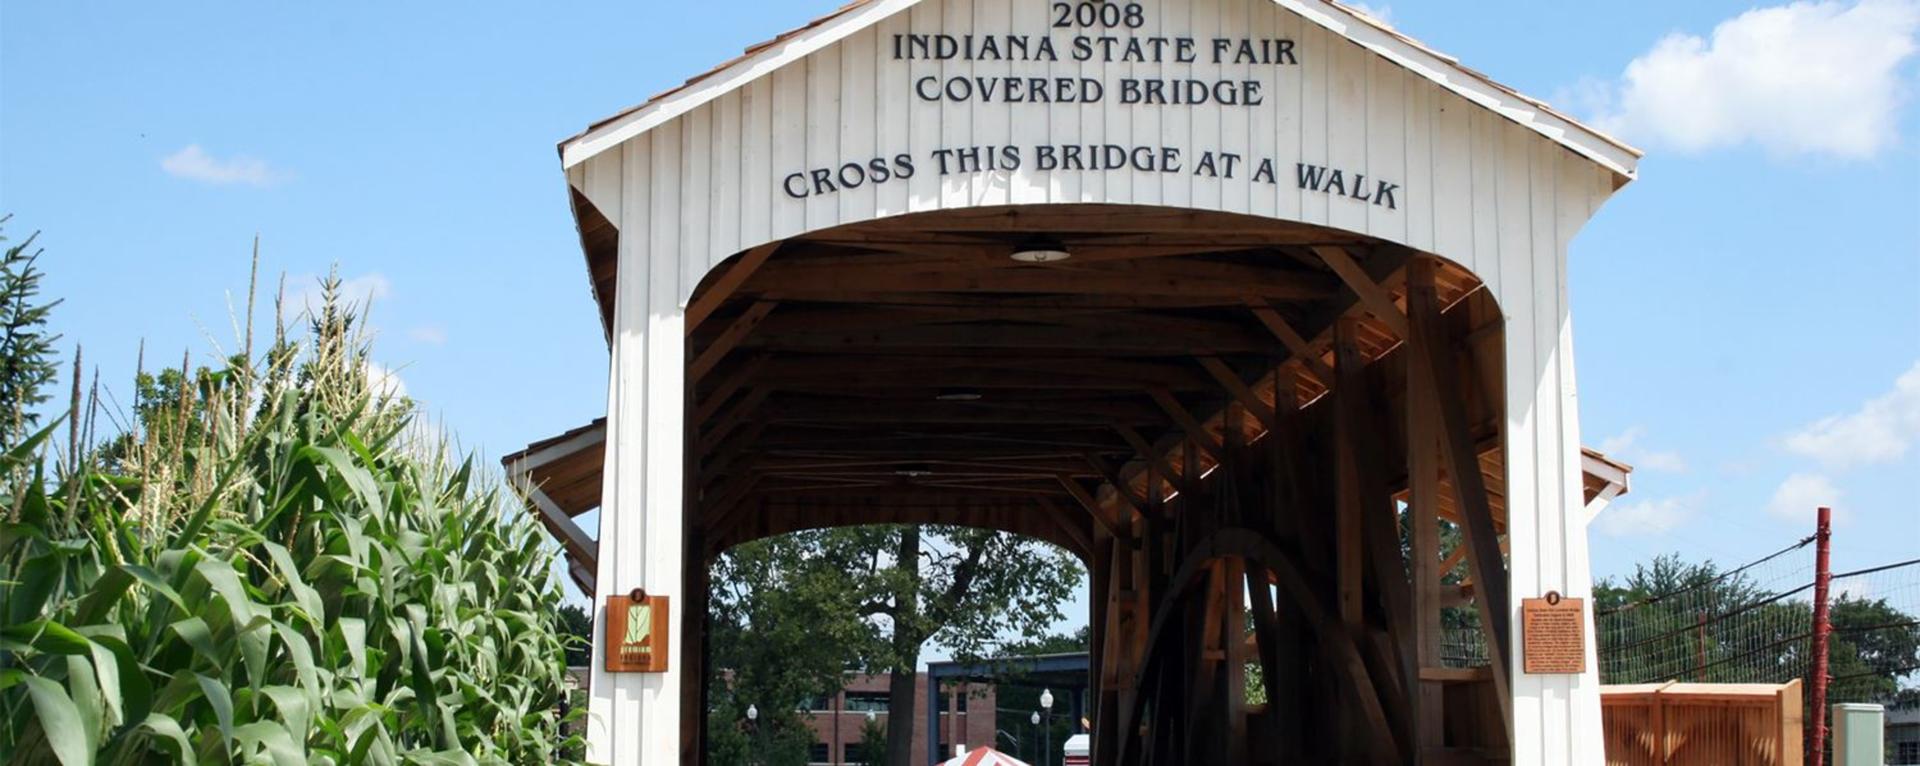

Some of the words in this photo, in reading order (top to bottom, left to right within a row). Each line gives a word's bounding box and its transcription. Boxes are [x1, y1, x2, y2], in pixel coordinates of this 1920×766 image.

[1052, 2, 1145, 29] 2008
[892, 34, 1058, 62] INDIANA
[1071, 35, 1197, 64] STATE
[1211, 38, 1298, 65] FAIR
[915, 76, 1104, 104] COVERED
[1119, 79, 1263, 107] BRIDGE
[783, 153, 915, 199] CROSS
[931, 145, 1021, 176] THIS
[1035, 144, 1182, 173] BRIDGE
[1193, 151, 1242, 179] AT
[1252, 158, 1276, 184] A
[1296, 163, 1400, 210] WALK
